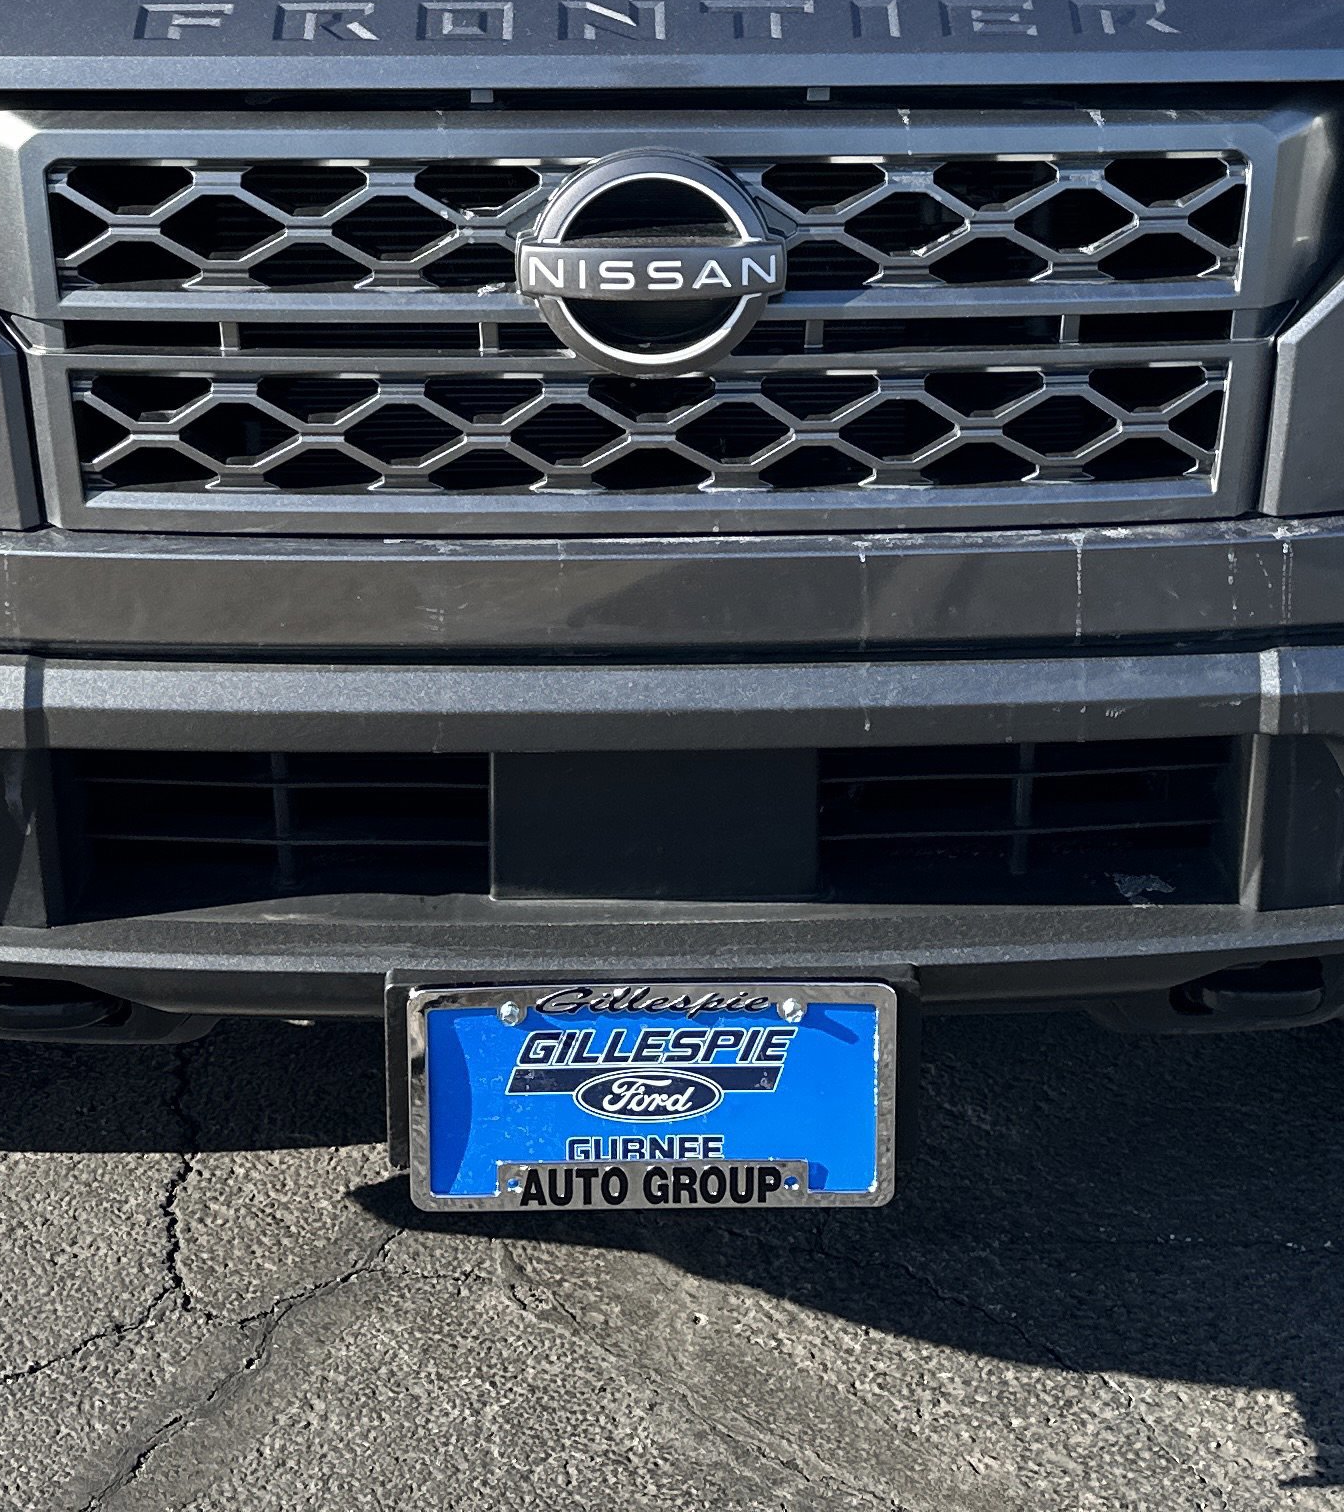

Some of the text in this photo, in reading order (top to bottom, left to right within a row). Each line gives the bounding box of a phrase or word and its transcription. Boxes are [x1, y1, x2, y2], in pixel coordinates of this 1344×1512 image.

[528, 254, 777, 290] NISSAN
[535, 986, 769, 1019] Gillespie
[516, 1026, 799, 1066] GILLESPIE
[602, 1077, 696, 1112] Ford
[565, 1133, 725, 1161] GURNEE
[520, 1165, 782, 1207] AUTO GROUP
